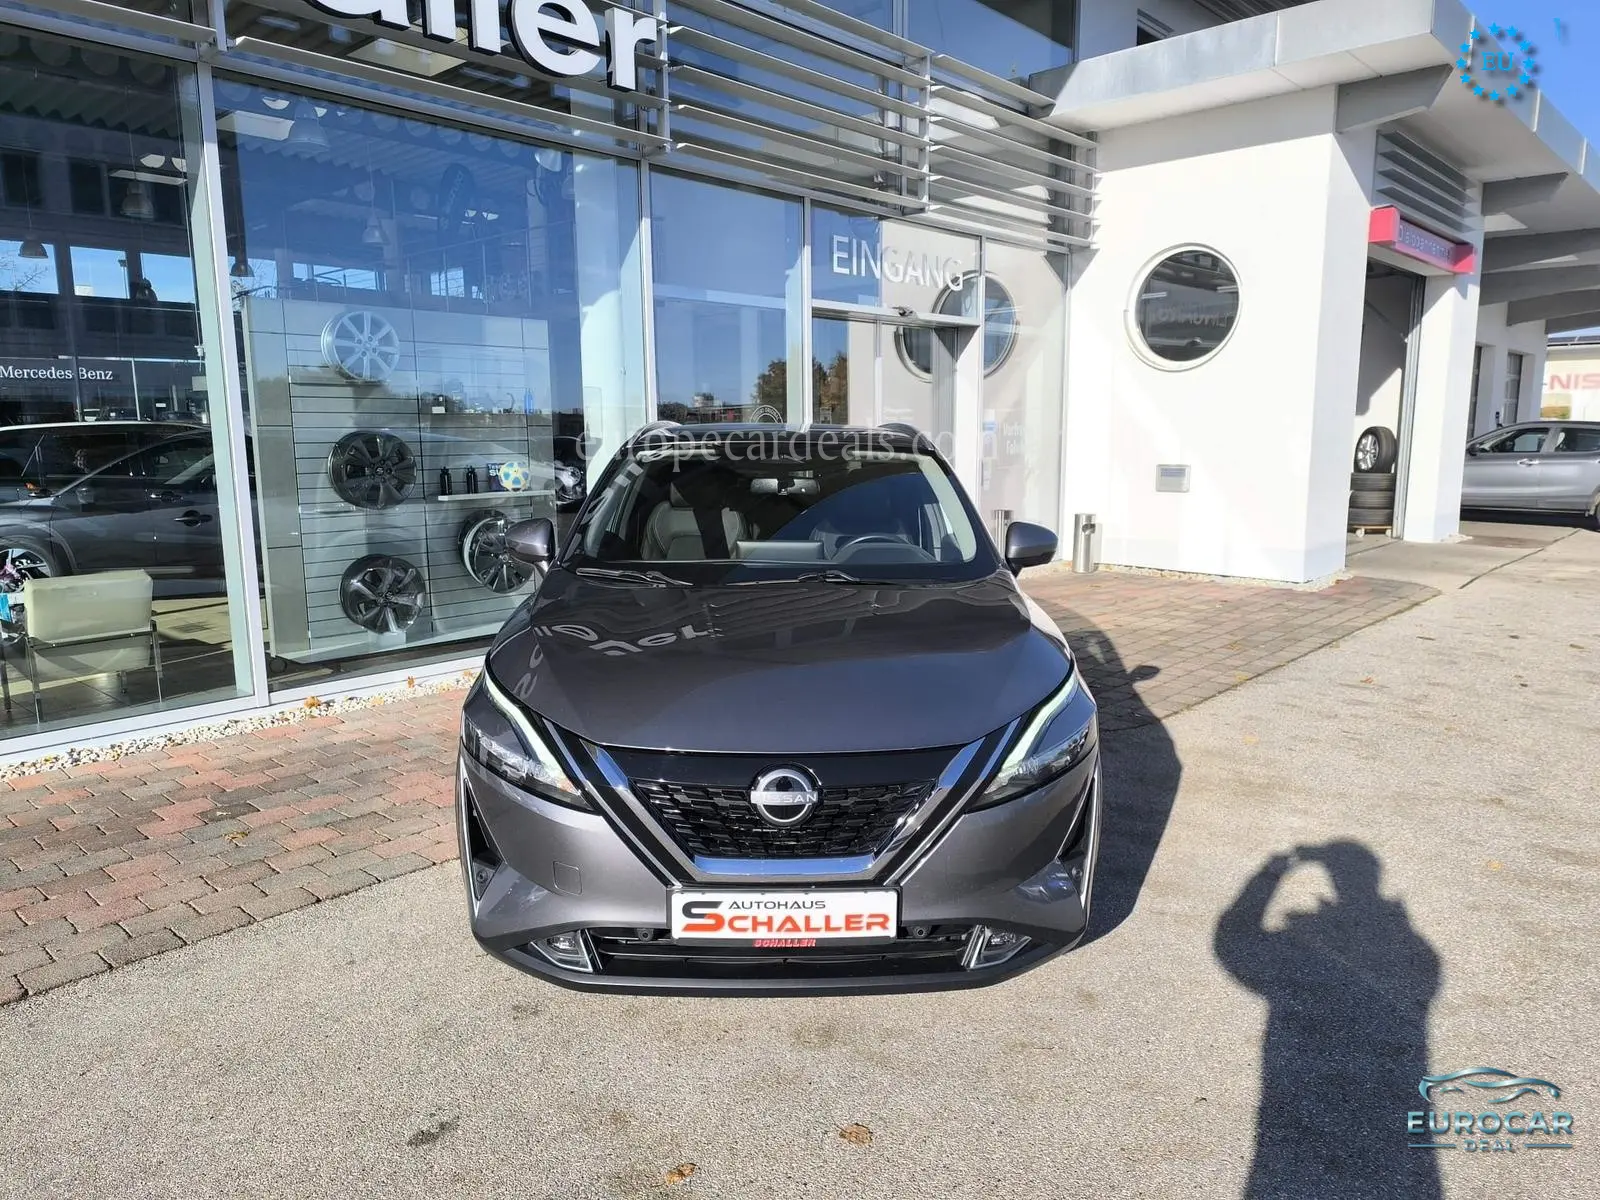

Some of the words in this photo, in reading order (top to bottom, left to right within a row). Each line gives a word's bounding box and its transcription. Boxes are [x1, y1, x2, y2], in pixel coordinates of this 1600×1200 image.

[833, 234, 964, 292] EINGANG
[0, 365, 114, 381] Mercedes-Benz
[753, 792, 819, 803] ISSAN
[728, 900, 826, 910] AUTOHAUS
[682, 900, 890, 933] SCHALLER
[752, 938, 817, 948] SCHALLER
